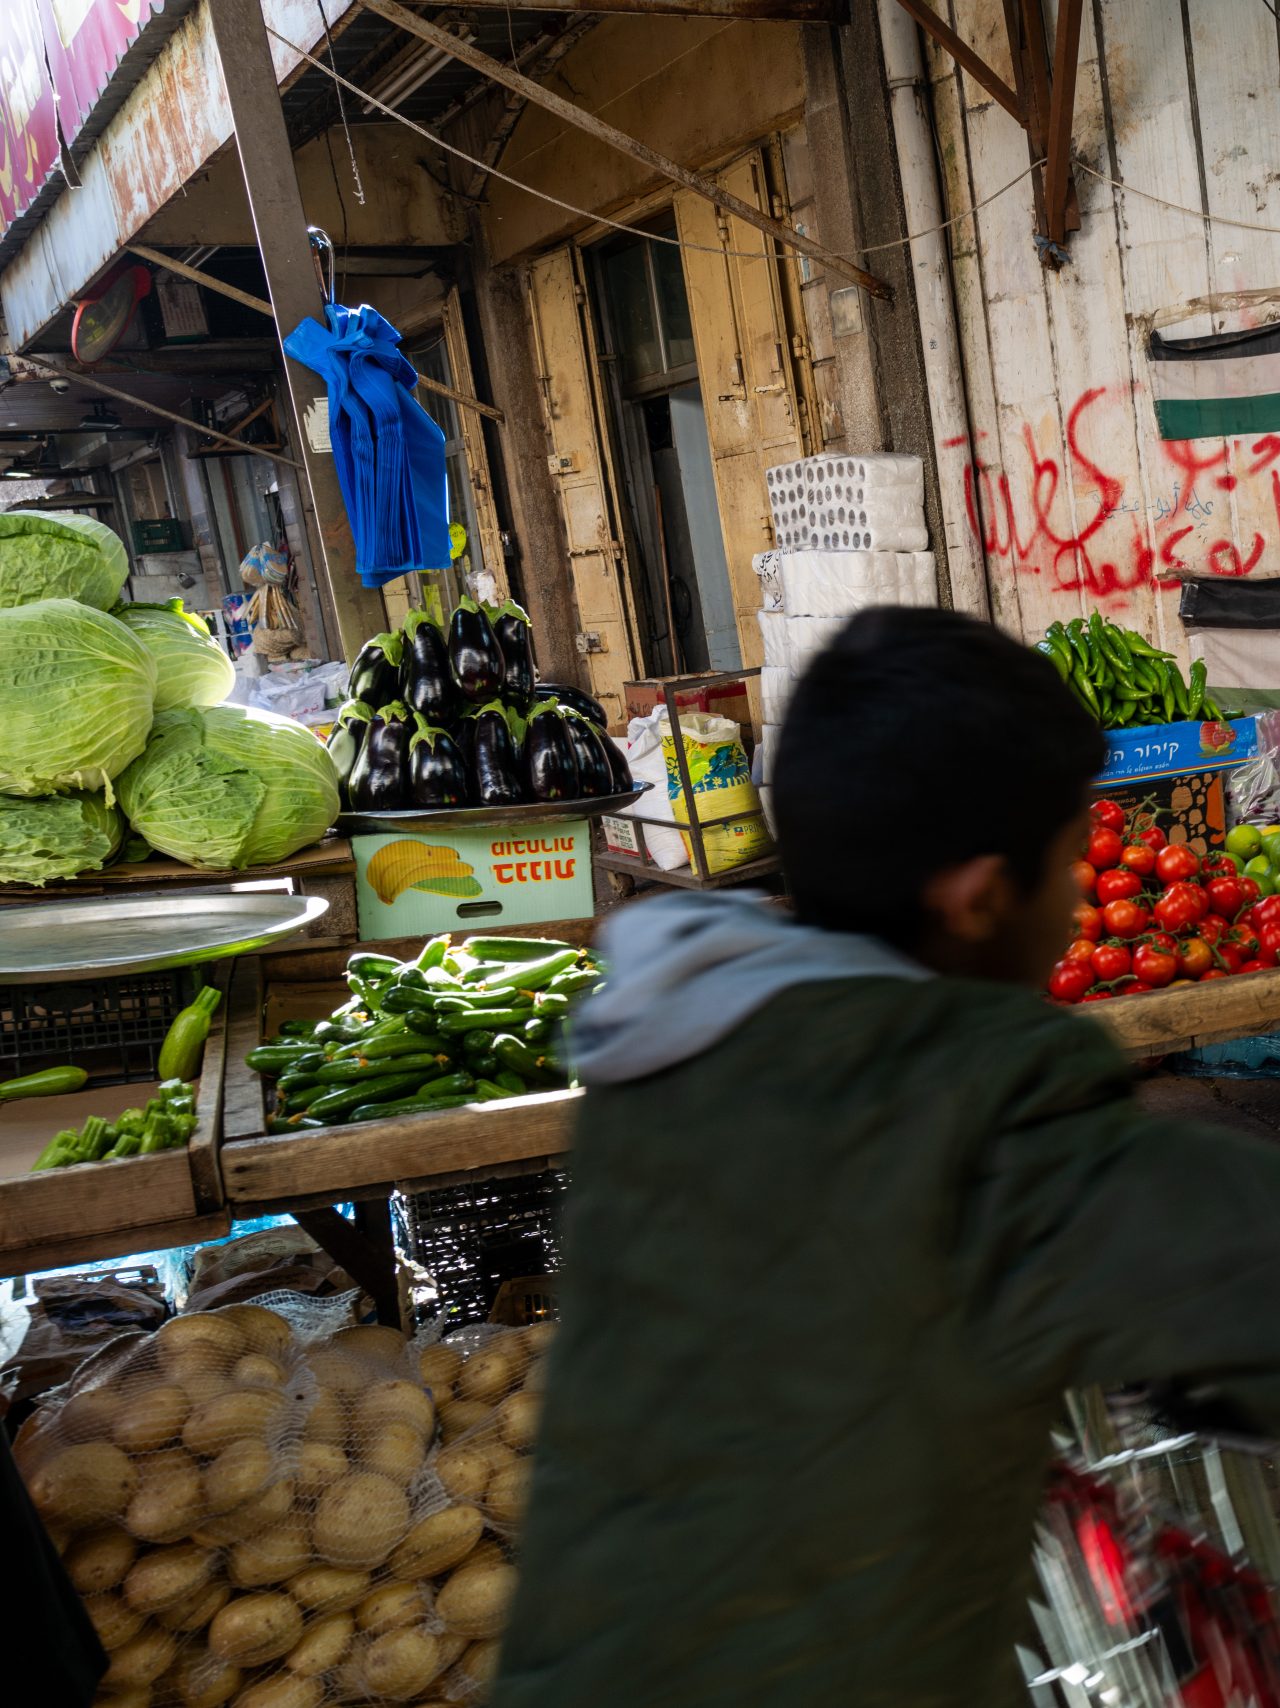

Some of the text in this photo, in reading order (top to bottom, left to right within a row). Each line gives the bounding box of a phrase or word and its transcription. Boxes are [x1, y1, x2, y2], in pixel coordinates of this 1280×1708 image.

[1133, 741, 1180, 763] קירור
[490, 836, 575, 858] מובחרות
[492, 857, 576, 885] בננות
